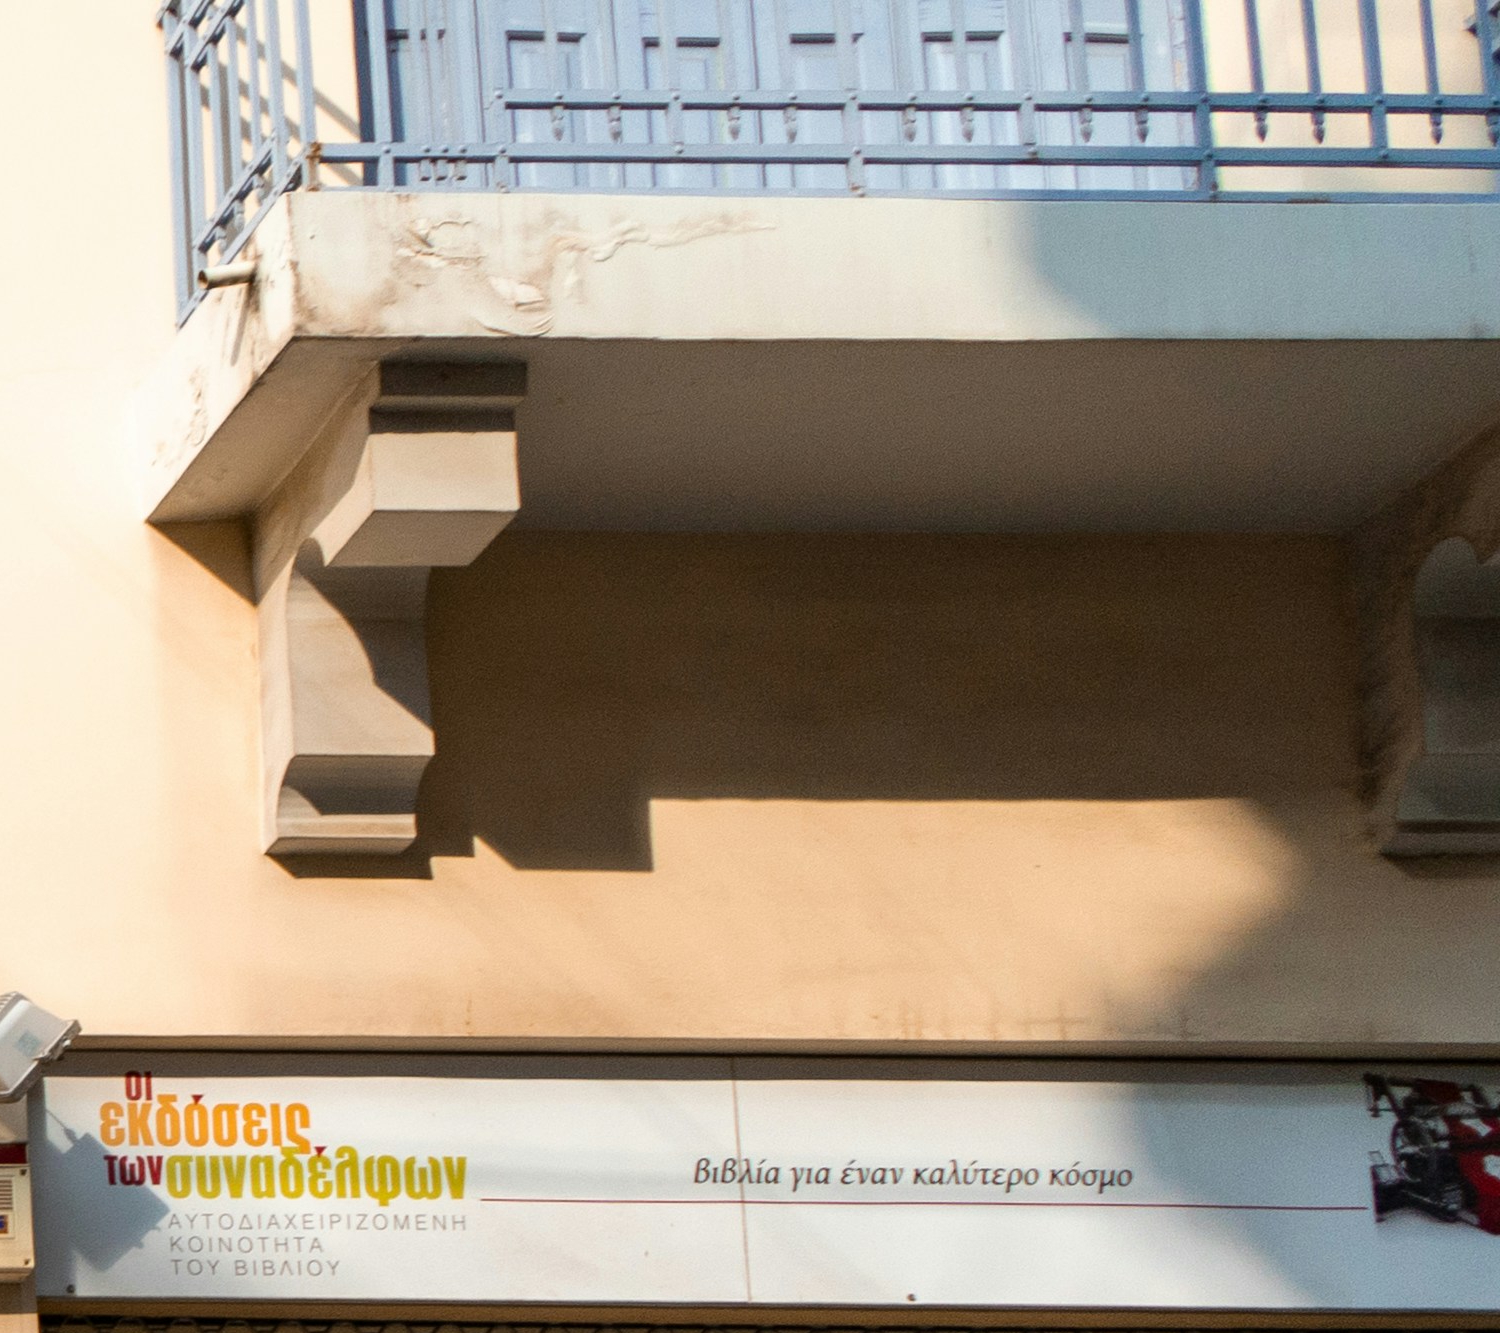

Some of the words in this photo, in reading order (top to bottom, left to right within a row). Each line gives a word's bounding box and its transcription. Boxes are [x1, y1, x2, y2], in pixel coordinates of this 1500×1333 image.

[100, 1093, 311, 1155] εκδόσεις
[104, 1154, 163, 1187] των
[166, 1146, 468, 1206] συναδέλφων
[693, 1157, 782, 1190] βιβλία
[789, 1163, 832, 1192] για
[840, 1160, 904, 1187] έναν
[912, 1160, 1040, 1194] καλύτερο
[1048, 1159, 1134, 1194] κόσμο
[169, 1213, 468, 1232] ΑΥΤΟΔΙΑΧΕΙΡΙΖΟΜΕΝΗ
[169, 1236, 325, 1255] ΚΟΙΝΟΤΗΤΑ
[171, 1259, 223, 1277] ΤΟΥ
[234, 1259, 341, 1278] ΒΙΒΛΙΟΥ
